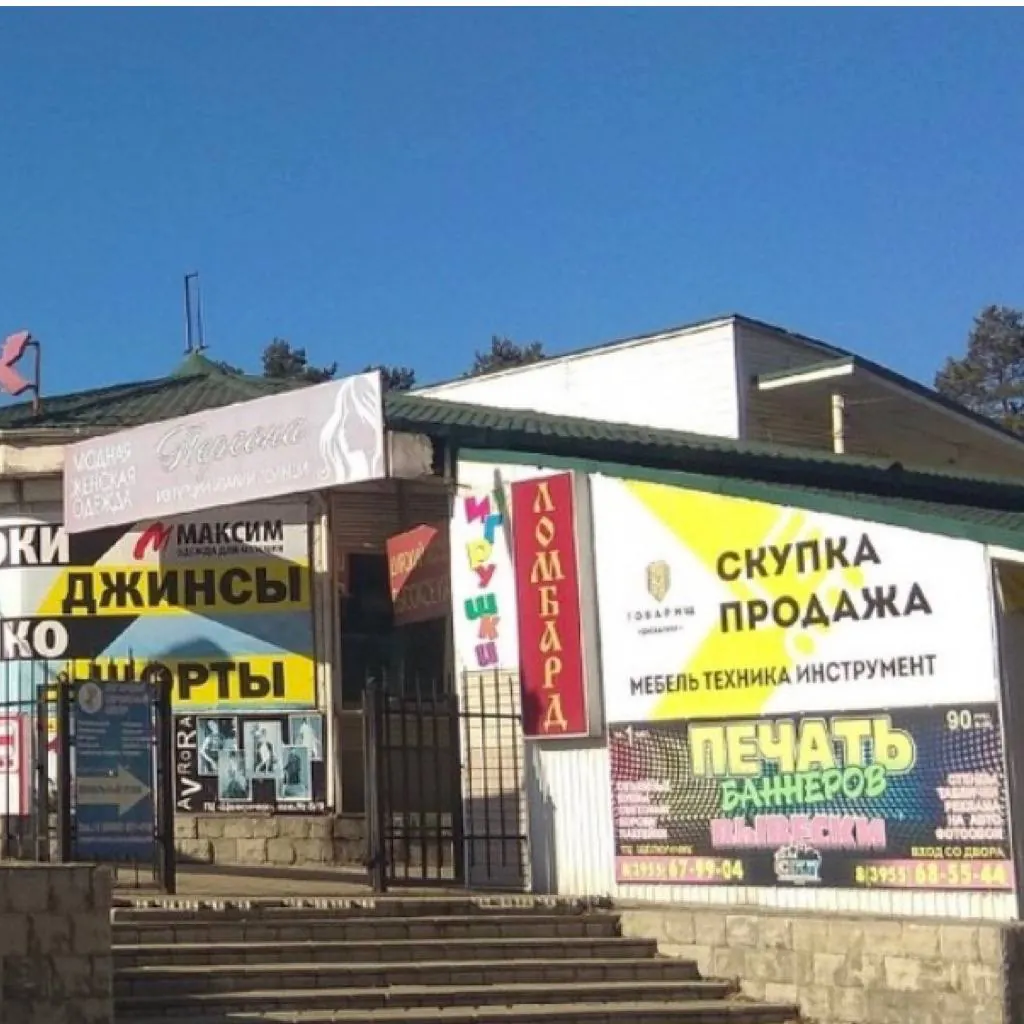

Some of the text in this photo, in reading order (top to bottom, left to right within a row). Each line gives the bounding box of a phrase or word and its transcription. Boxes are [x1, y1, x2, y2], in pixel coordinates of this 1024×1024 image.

[176, 521, 285, 546] МАКСИМ
[717, 533, 881, 582] СКУПКА
[62, 565, 302, 614] ДЖИНСЫ
[530, 482, 569, 732] ЛОМБАРД
[719, 582, 933, 633] ПРОДАЖА
[630, 654, 937, 696] МЕБЕЛЬ ТЕХНИКА ИНСТРУМЕНТ
[946, 709, 972, 730] 90
[688, 714, 917, 778] ПЕЧАТЬ
[721, 763, 888, 812] БАННЕРОВ
[711, 814, 888, 851] ВЫВЕСКИ
